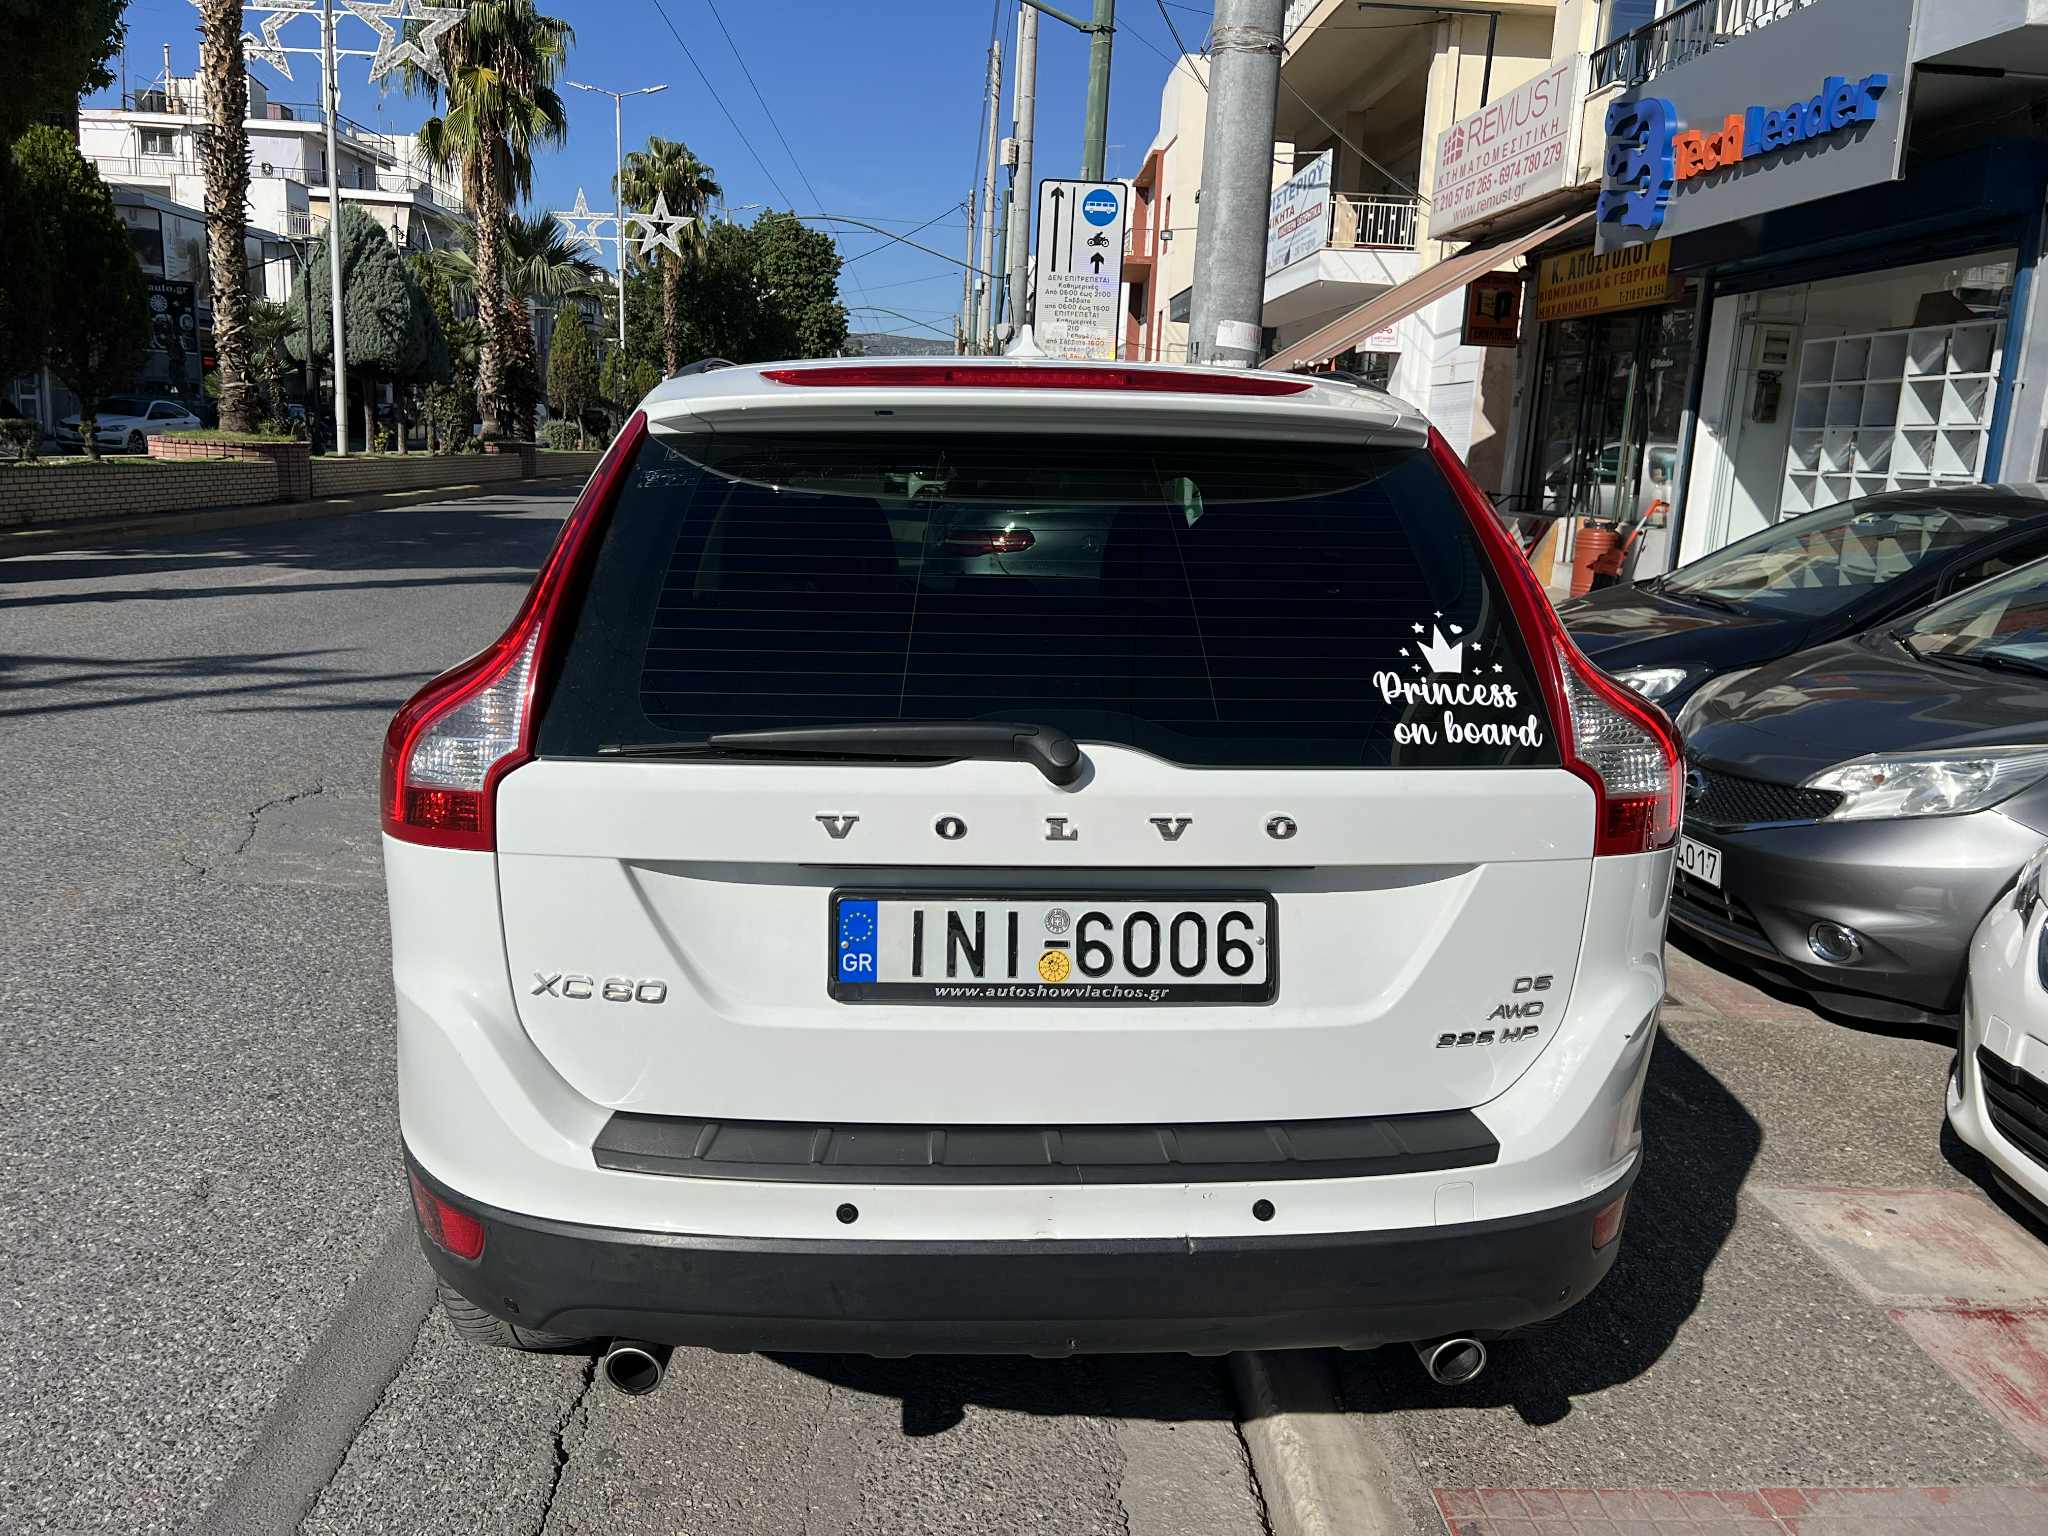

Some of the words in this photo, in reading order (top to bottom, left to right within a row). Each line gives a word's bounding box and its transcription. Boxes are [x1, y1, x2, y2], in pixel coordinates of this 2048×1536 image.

[1467, 66, 1568, 152] REMUST
[1438, 117, 1560, 189] ΚΤΗΜΑΤΟΜΕΣΙΤΙΚΗ
[1453, 181, 1527, 223] www.remust.gr
[1065, 275, 1110, 283] ΕΠΙΤΡΕΠΕΤΑΙ
[1373, 671, 1518, 708] Princess
[1394, 722, 1437, 745] on
[1444, 710, 1543, 747] board
[842, 953, 872, 972] GR
[935, 985, 1169, 1000] www.autoshowvlachos.gr
[1513, 976, 1554, 993] D5
[1486, 1001, 1544, 1020] AWD
[1500, 1025, 1539, 1043] HP
